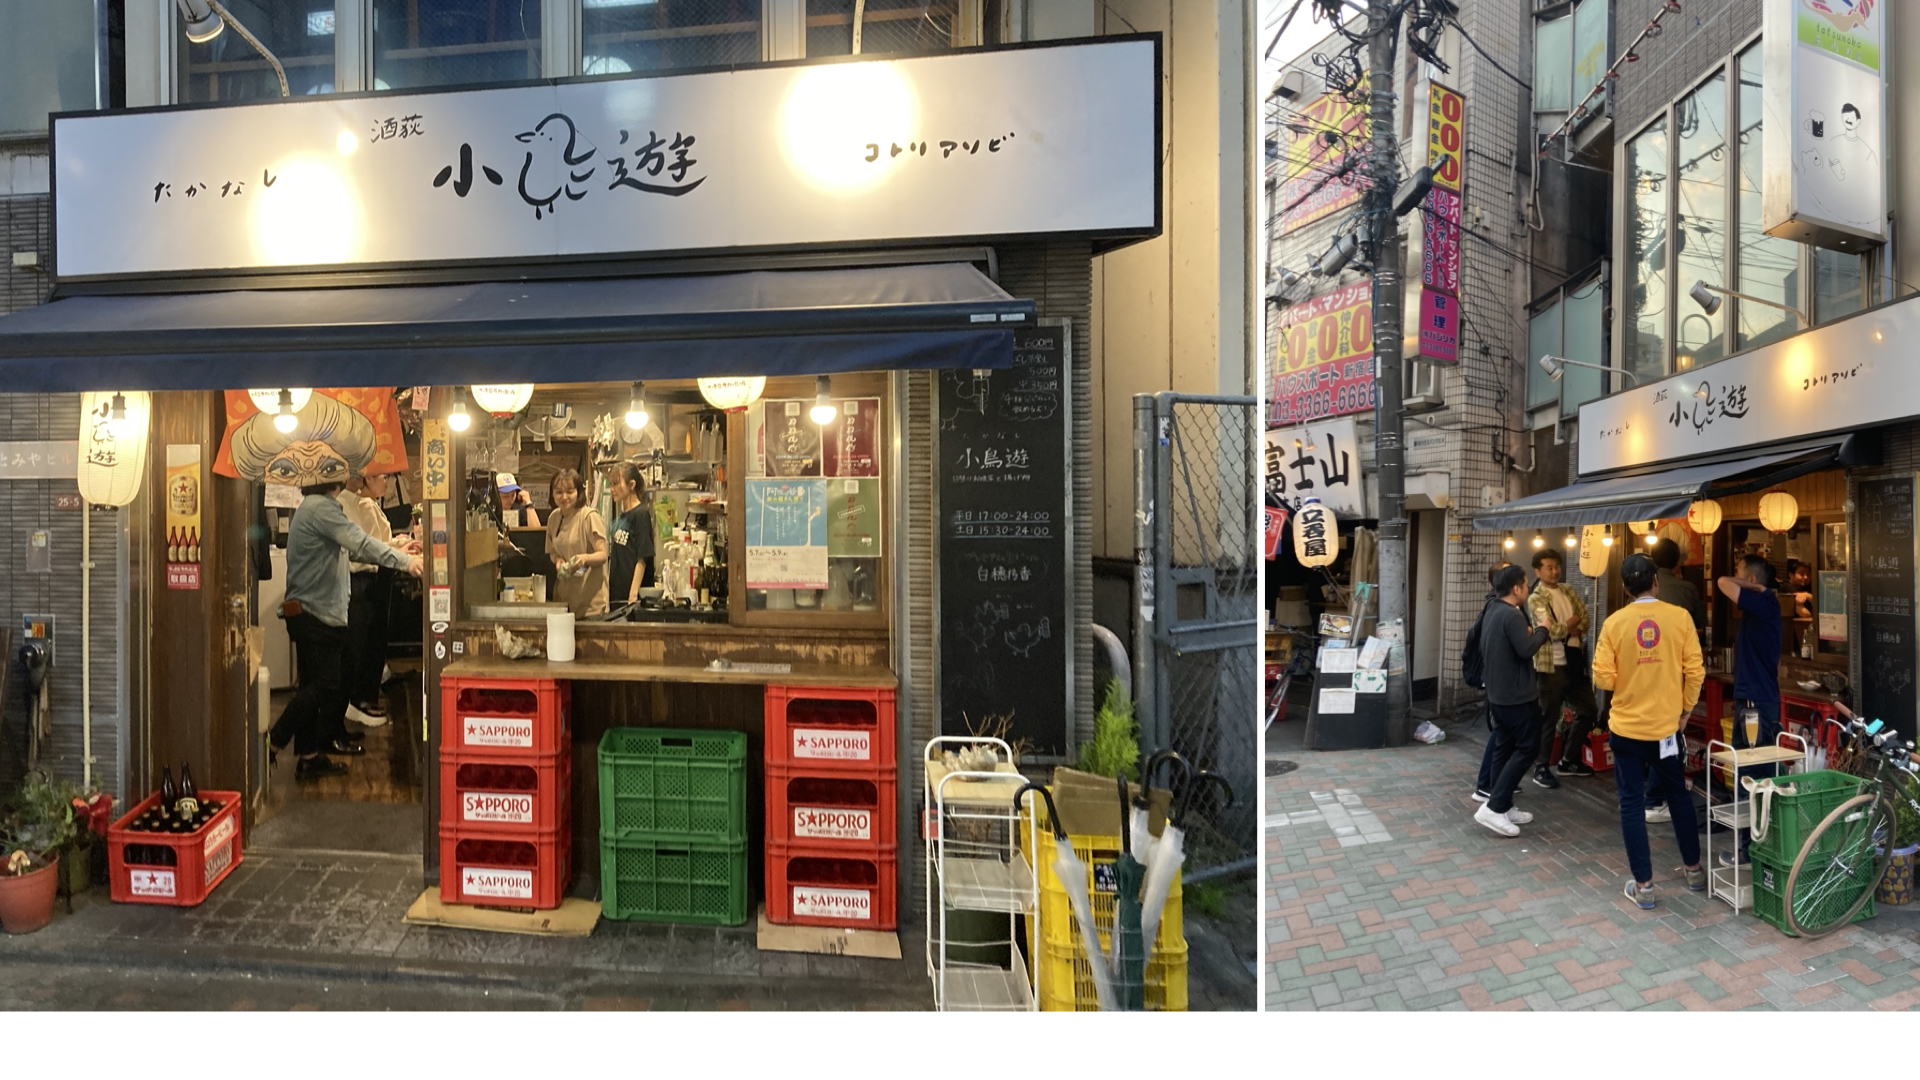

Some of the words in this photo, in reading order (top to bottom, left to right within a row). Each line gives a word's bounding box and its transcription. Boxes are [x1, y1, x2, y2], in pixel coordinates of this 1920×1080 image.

[864, 131, 1016, 163] コトリアソビ
[154, 168, 277, 203] たかなし
[1280, 287, 1374, 324] アパート・マンショ
[1433, 295, 1446, 330] 管理
[1317, 315, 1338, 361] 0
[1351, 304, 1373, 352] 0
[1287, 325, 1307, 369] 0
[1276, 365, 1340, 397] ハウスポート
[1802, 362, 1863, 391] コトリアソビ
[1274, 380, 1375, 424] 03-3366-6666
[426, 438, 446, 487] 商い中
[956, 446, 1030, 470] 小鳥遊
[955, 509, 973, 521] 平日
[978, 510, 1050, 521] 17:00-24:00
[955, 525, 974, 535] 土日
[979, 526, 1050, 537] 15:30-24:00
[1301, 508, 1327, 557] 立呑屋
[1866, 555, 1900, 570] 小鳥遊
[479, 725, 531, 738] SAPPORO
[810, 736, 868, 750] SAPPORO
[478, 874, 531, 889] SAPPORO
[810, 894, 869, 909] SAPPORO
